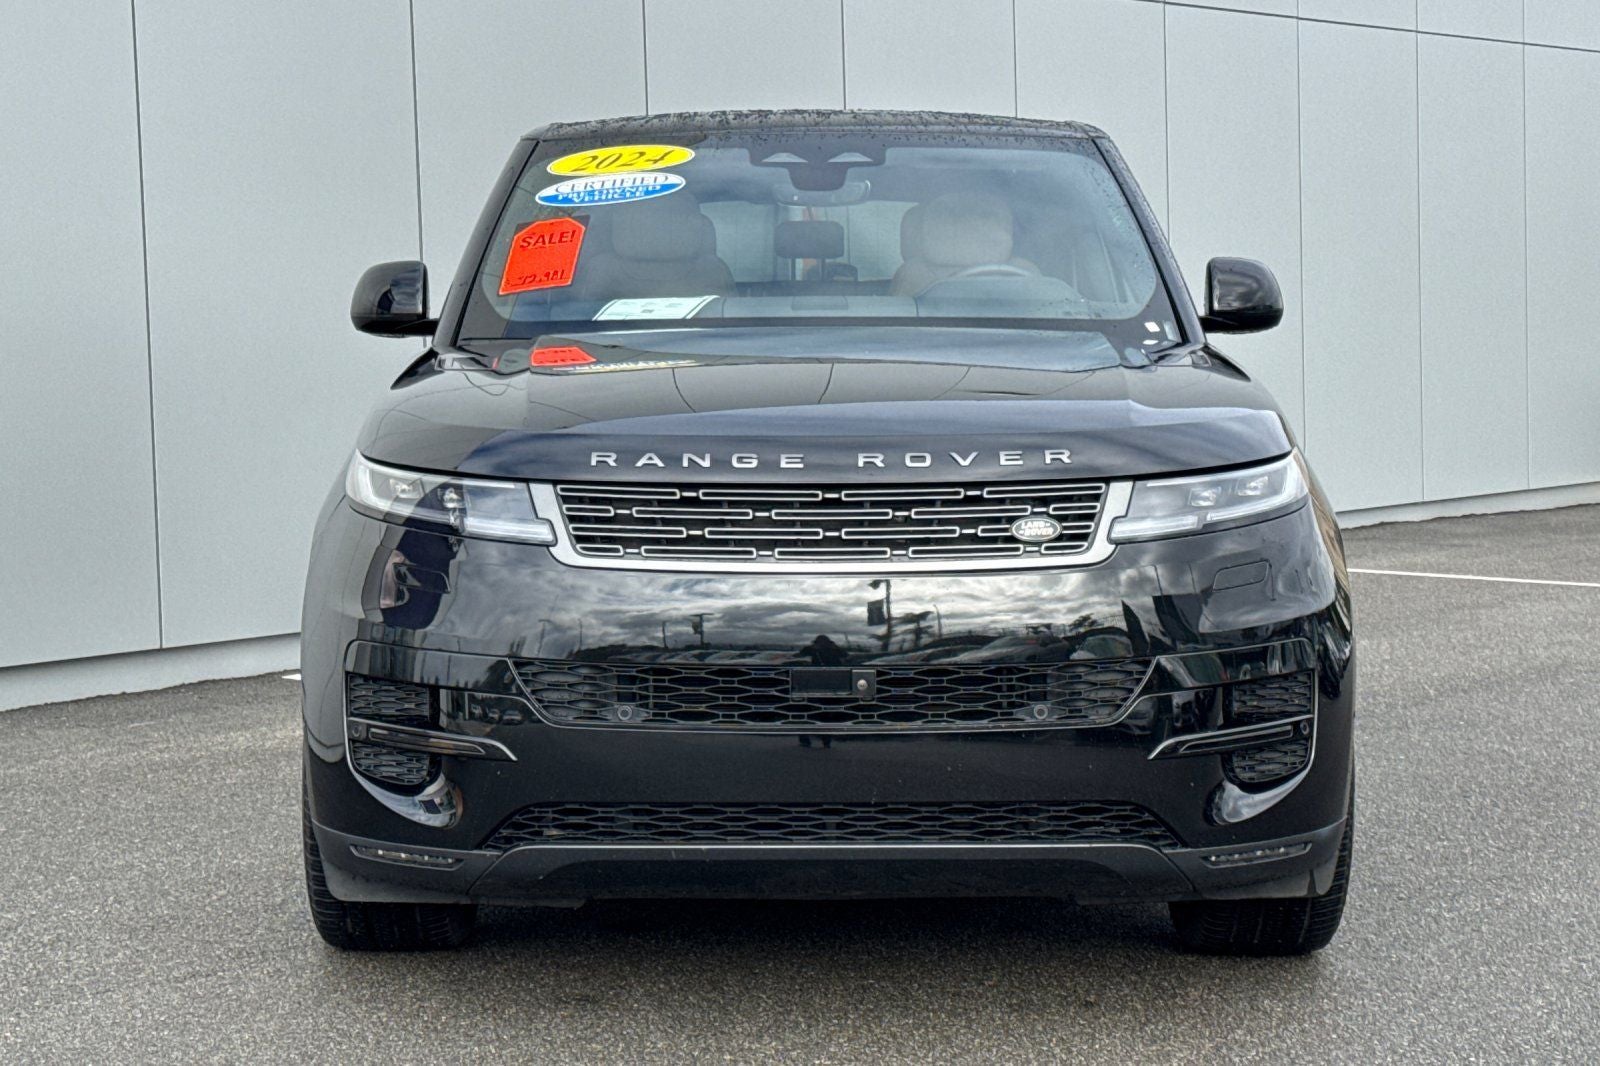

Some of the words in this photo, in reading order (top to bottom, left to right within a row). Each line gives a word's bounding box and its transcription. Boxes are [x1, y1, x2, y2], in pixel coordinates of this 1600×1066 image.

[570, 149, 675, 173] 2024
[555, 174, 669, 194] CERTIFIED
[519, 229, 577, 249] SALE!
[589, 451, 805, 469] RANGE
[857, 449, 1073, 468] ROVER
[1021, 520, 1046, 530] LAND
[1024, 526, 1054, 537] ROVER
